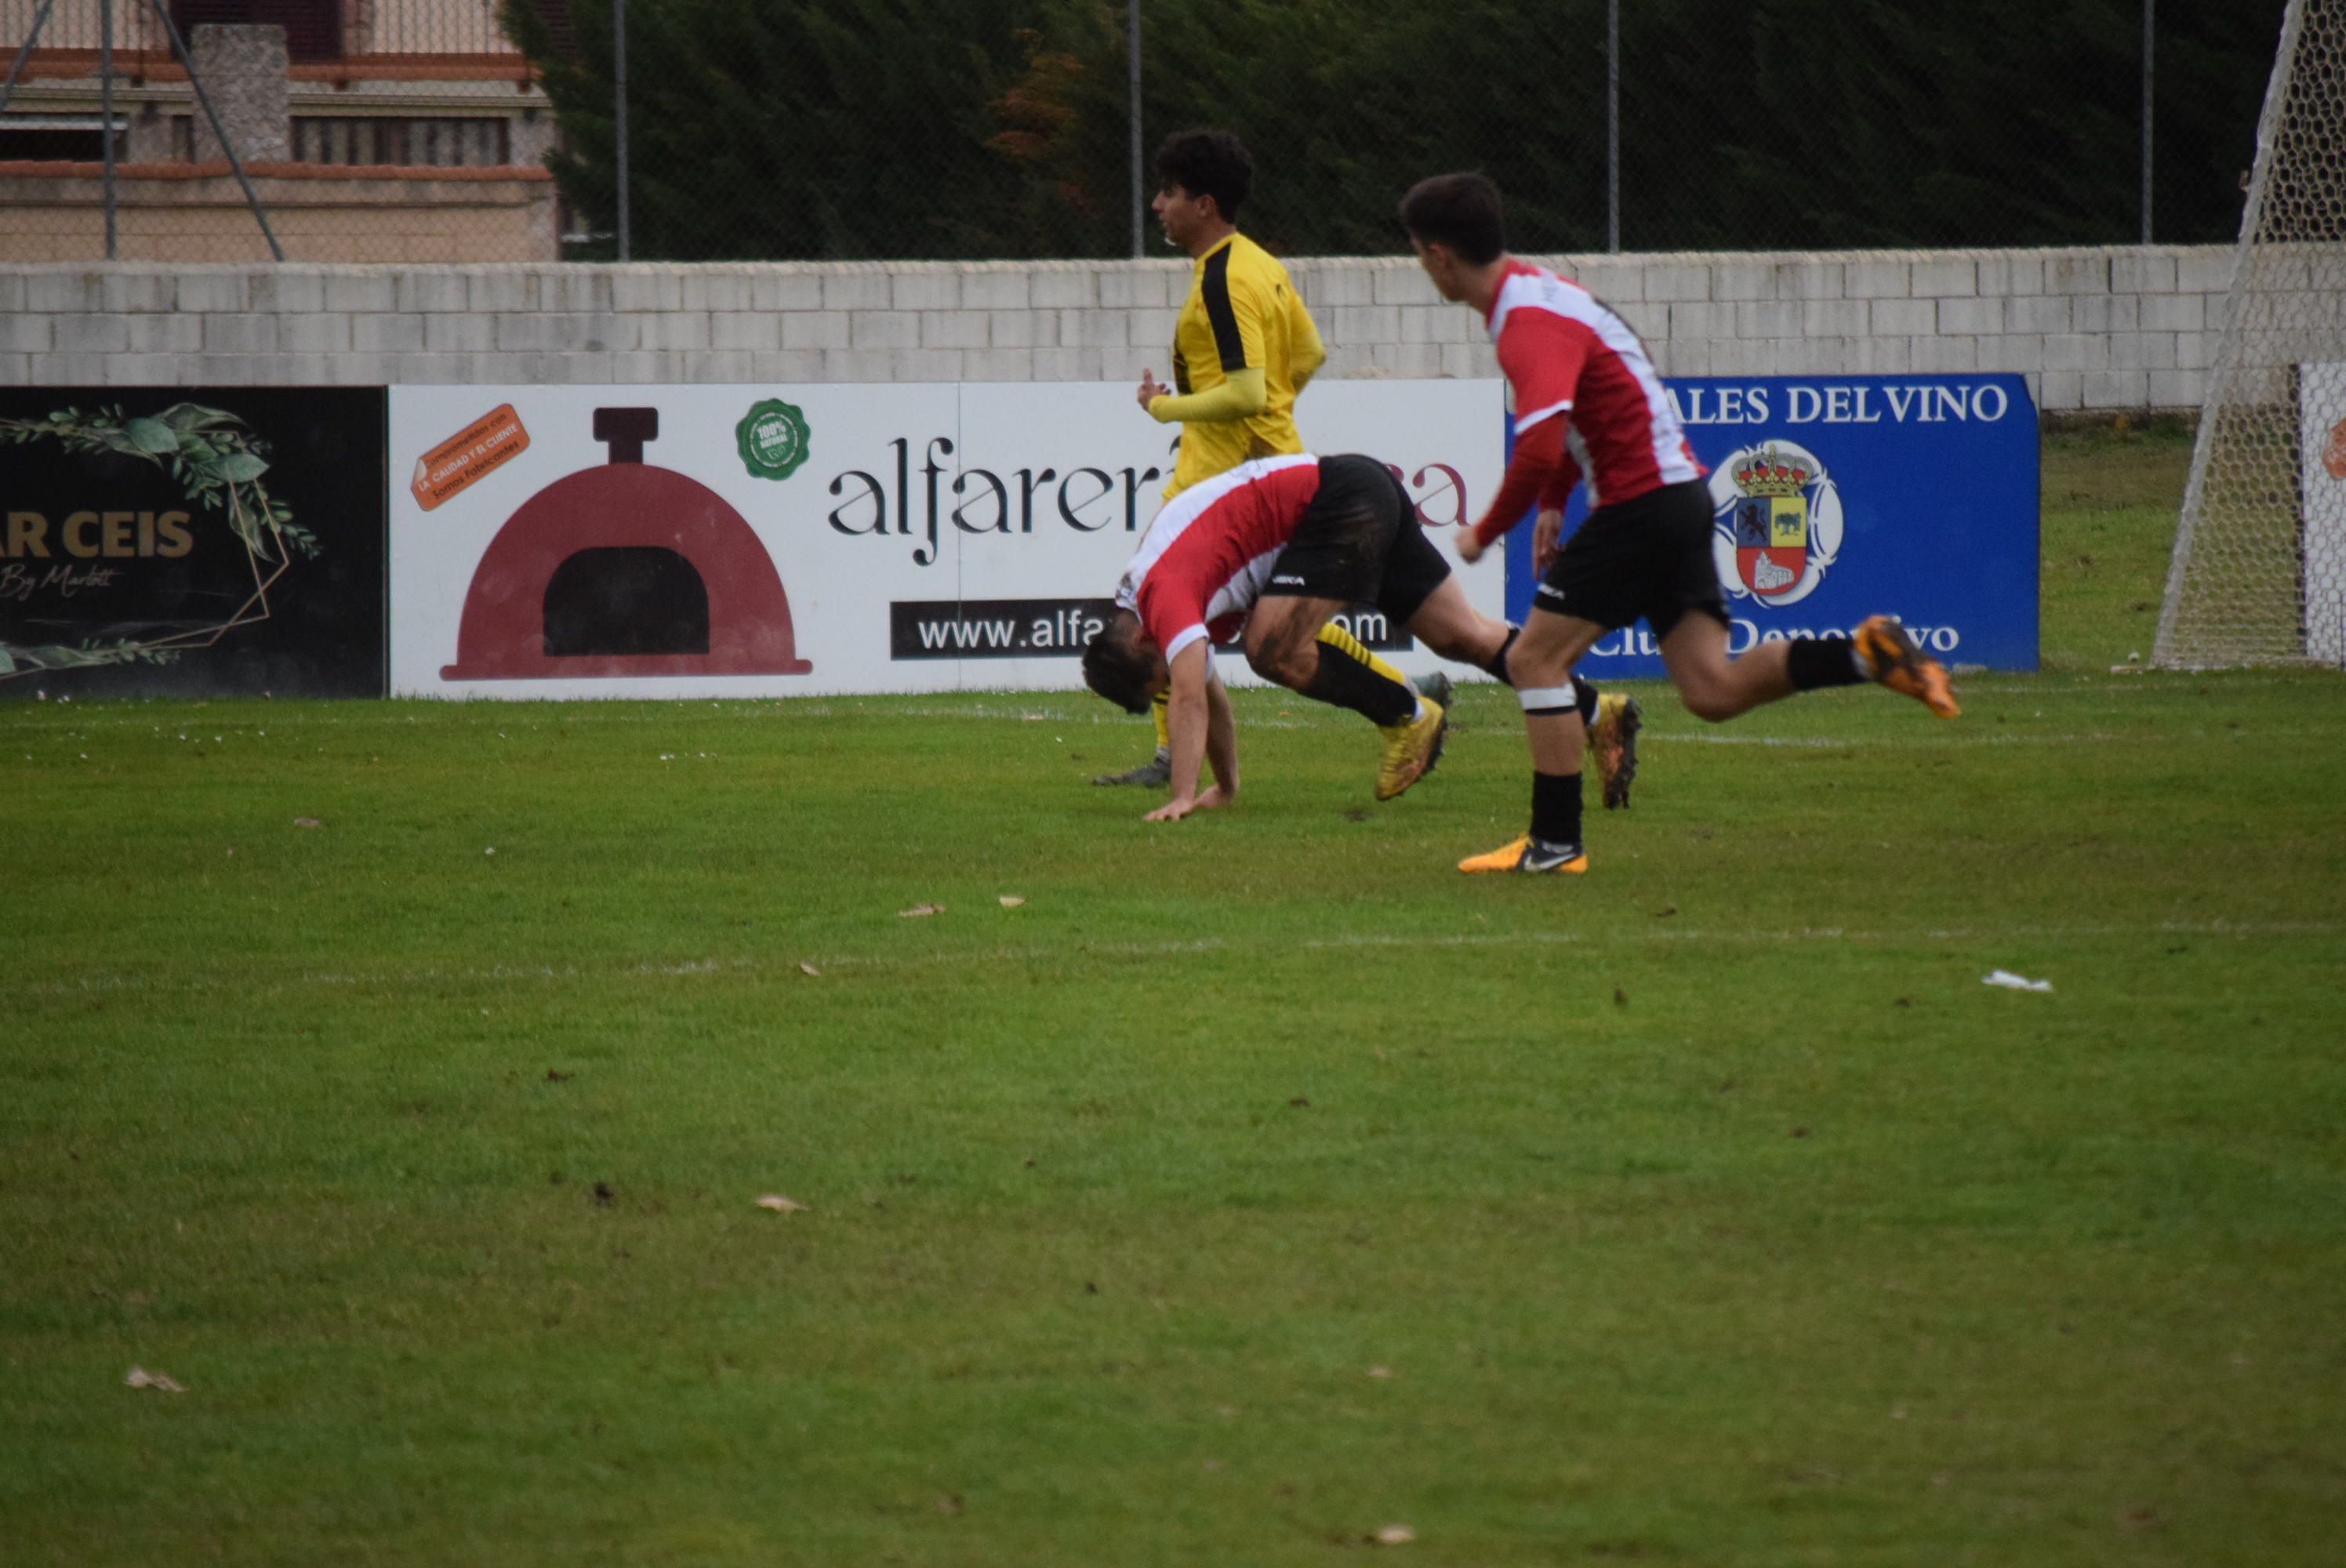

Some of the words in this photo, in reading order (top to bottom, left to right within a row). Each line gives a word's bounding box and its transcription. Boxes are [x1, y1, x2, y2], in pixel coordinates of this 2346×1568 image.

[490, 413, 507, 427] con
[1665, 387, 1770, 424] ALES
[1785, 387, 1881, 423] DEL
[1883, 384, 2008, 423] VINO
[757, 420, 786, 439] 100%
[418, 480, 430, 492] LA
[432, 454, 469, 482] CALIDAD
[468, 449, 476, 459] Y
[477, 445, 486, 456] EL
[486, 423, 518, 448] CLIENTE
[432, 475, 464, 499] Somos
[828, 436, 1182, 567] alfarer
[0, 512, 51, 558] R
[62, 510, 194, 559] CEIS
[918, 609, 1104, 649] www.alfa
[1589, 626, 1662, 656] Clu
